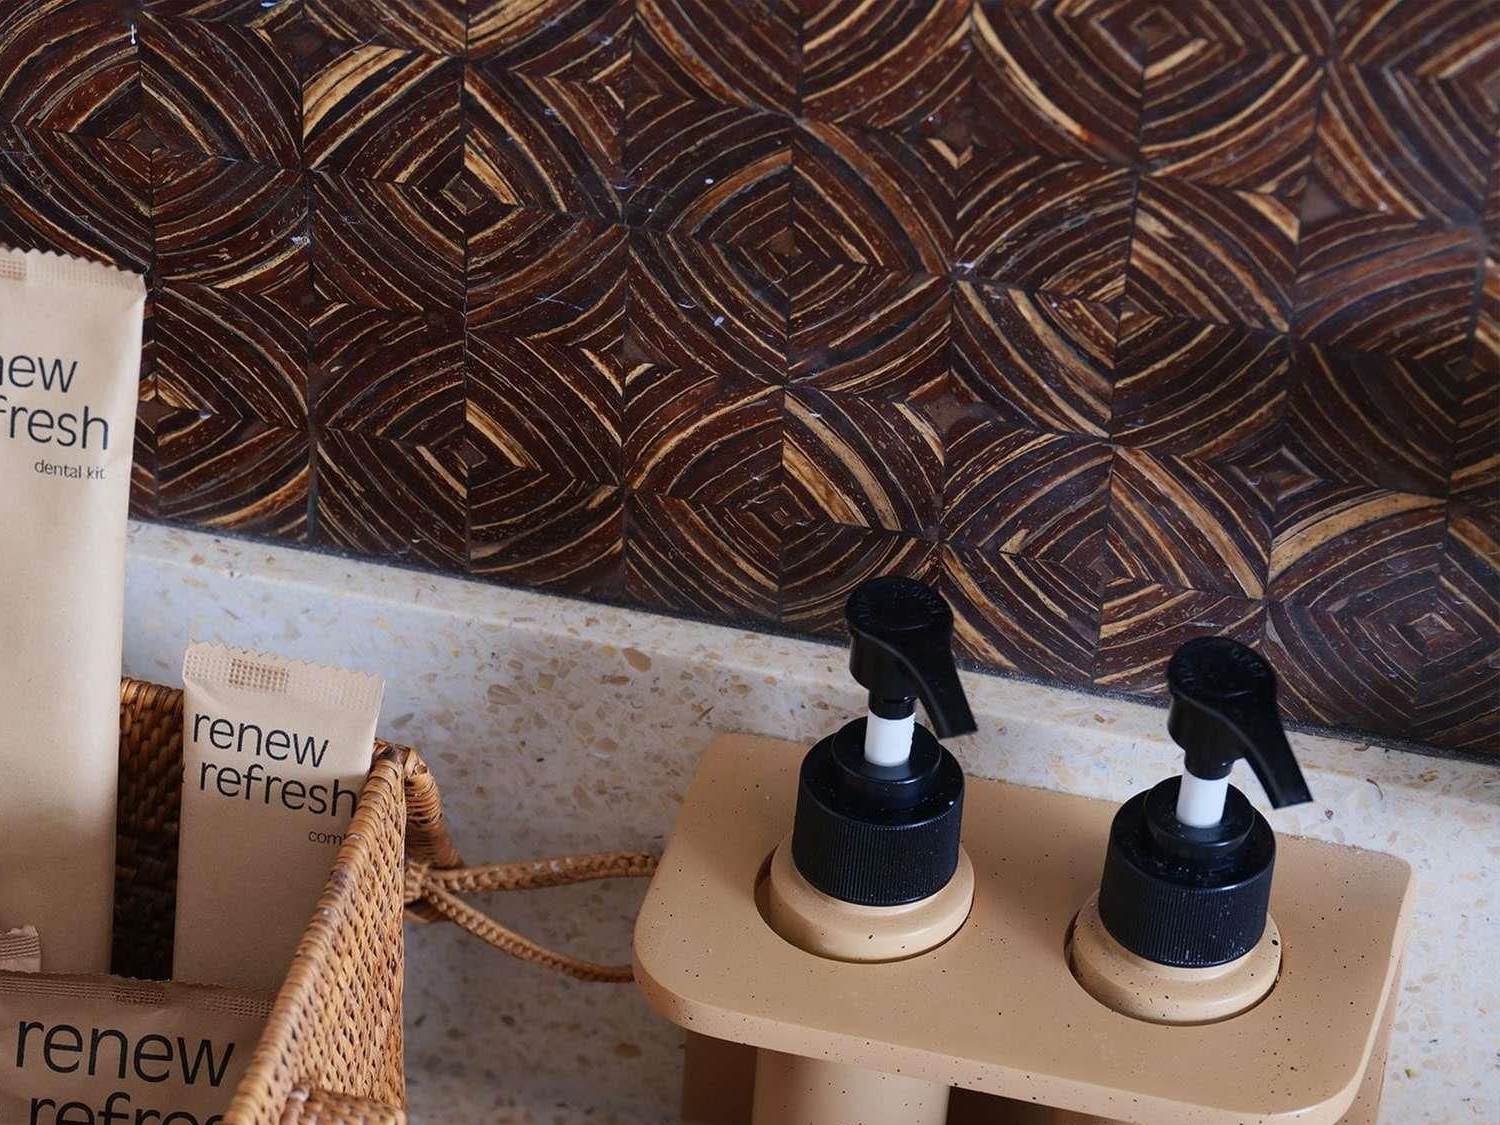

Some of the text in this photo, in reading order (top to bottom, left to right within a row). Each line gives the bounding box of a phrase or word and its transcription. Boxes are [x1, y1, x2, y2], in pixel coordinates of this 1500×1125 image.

[34, 459, 106, 480] dental kit
[193, 713, 329, 768] renew
[200, 762, 357, 818] refresh
[308, 831, 347, 846] com
[15, 1020, 236, 1087] renew
